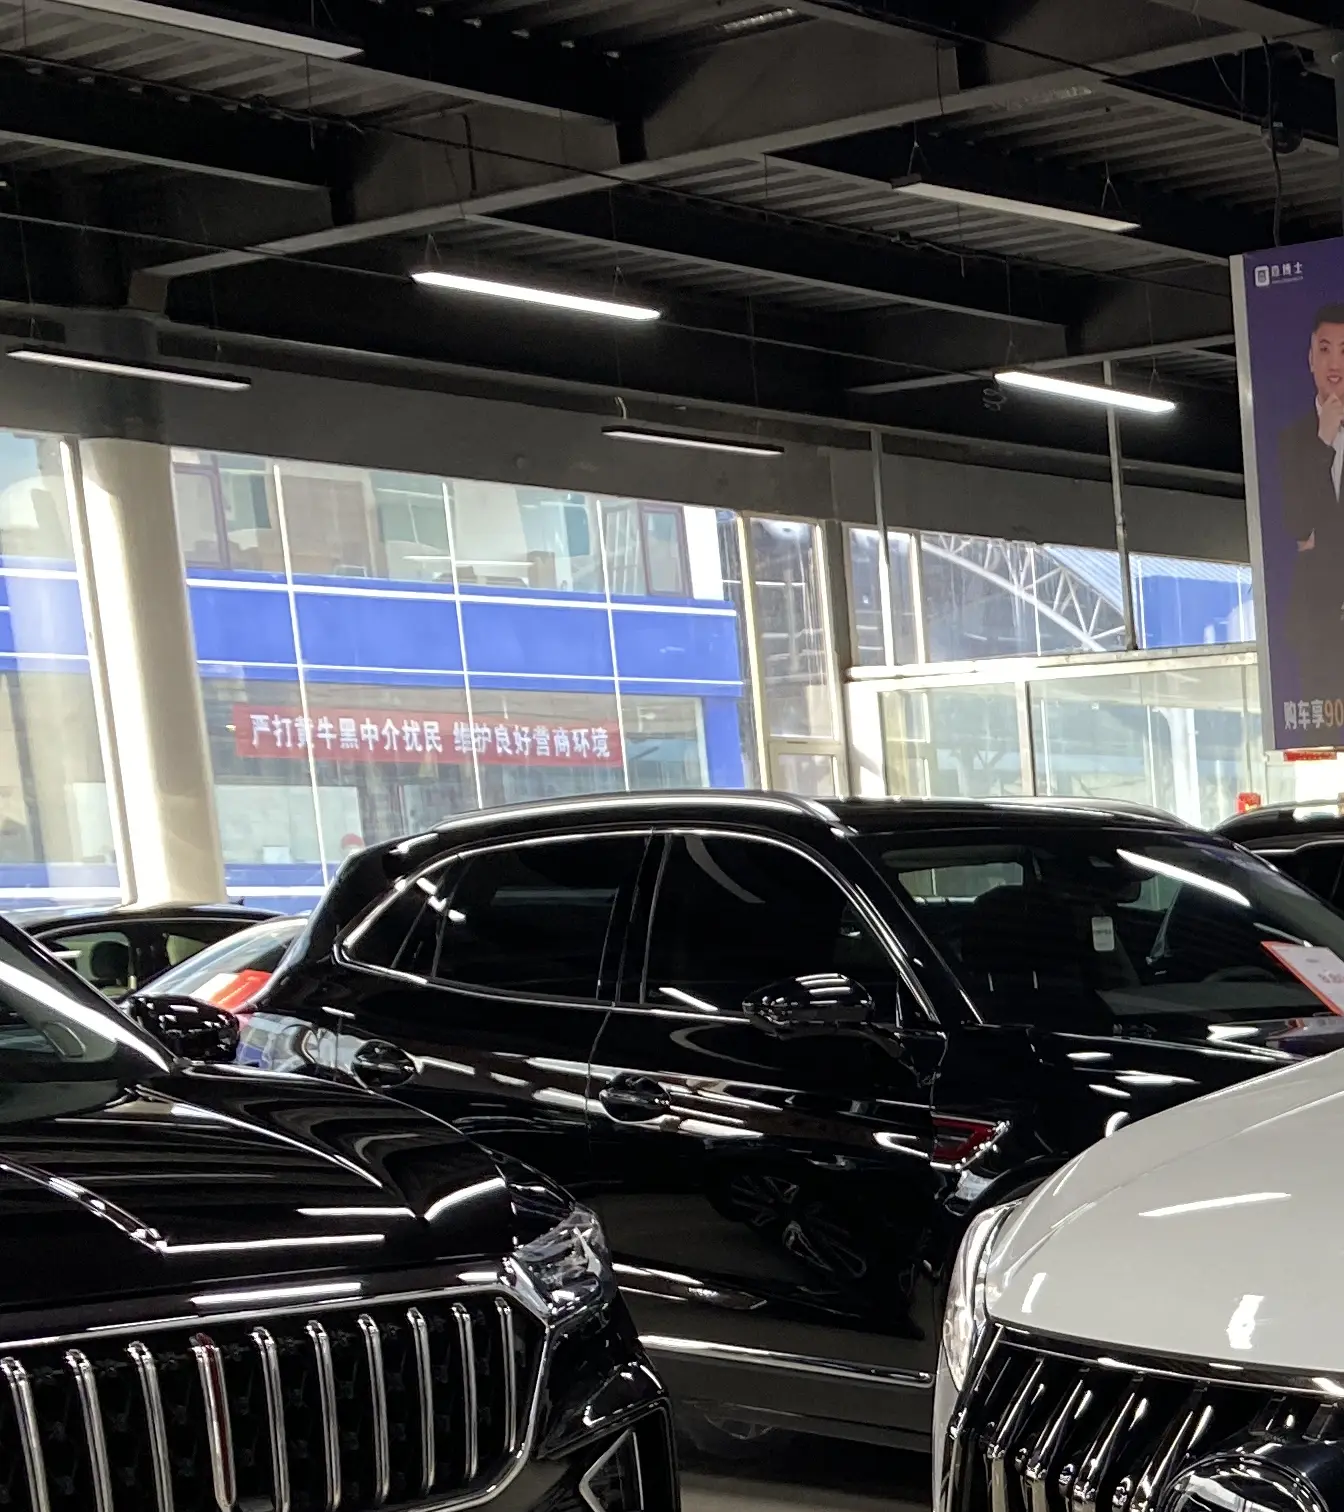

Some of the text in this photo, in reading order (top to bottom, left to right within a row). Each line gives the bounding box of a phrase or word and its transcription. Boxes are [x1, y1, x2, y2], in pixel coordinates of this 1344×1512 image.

[250, 714, 610, 758] 严打黄牛黑中介扰民 维护良好营商环境
